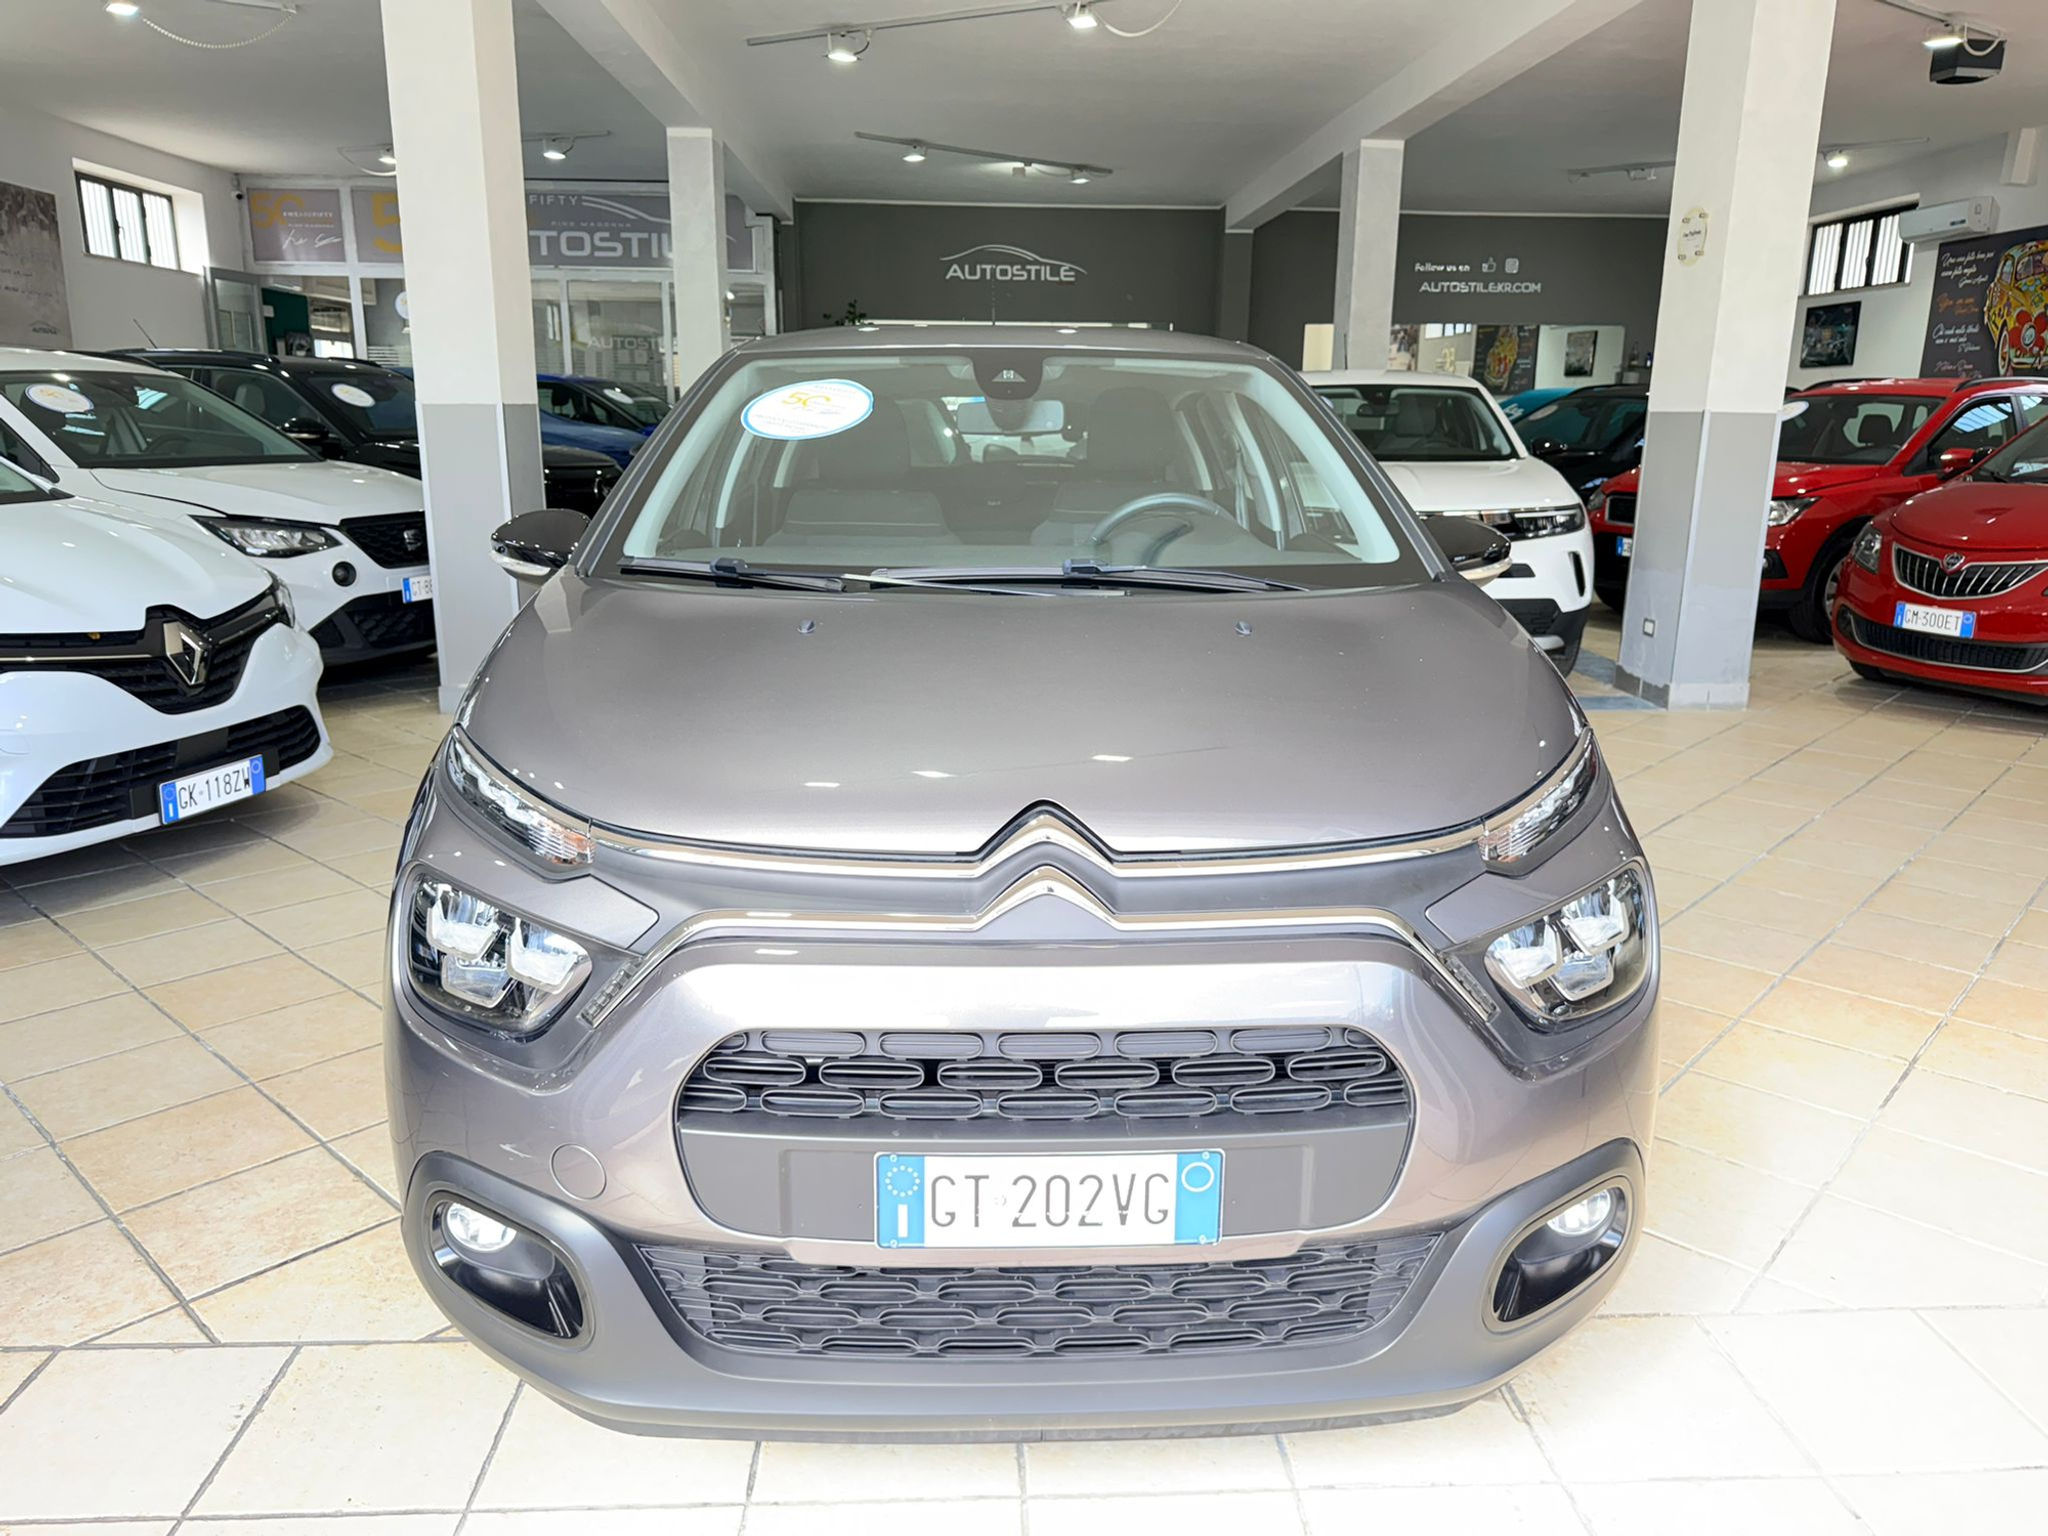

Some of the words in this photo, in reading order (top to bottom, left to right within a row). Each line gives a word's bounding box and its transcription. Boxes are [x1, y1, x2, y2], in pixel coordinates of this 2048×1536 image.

[945, 263, 1076, 282] AUTOSTILE
[1922, 610, 1961, 631] 300ET
[178, 783, 198, 810] GK
[206, 766, 250, 801] 118ZW
[930, 1174, 990, 1229] GT
[1011, 1173, 1170, 1228] 202VG
